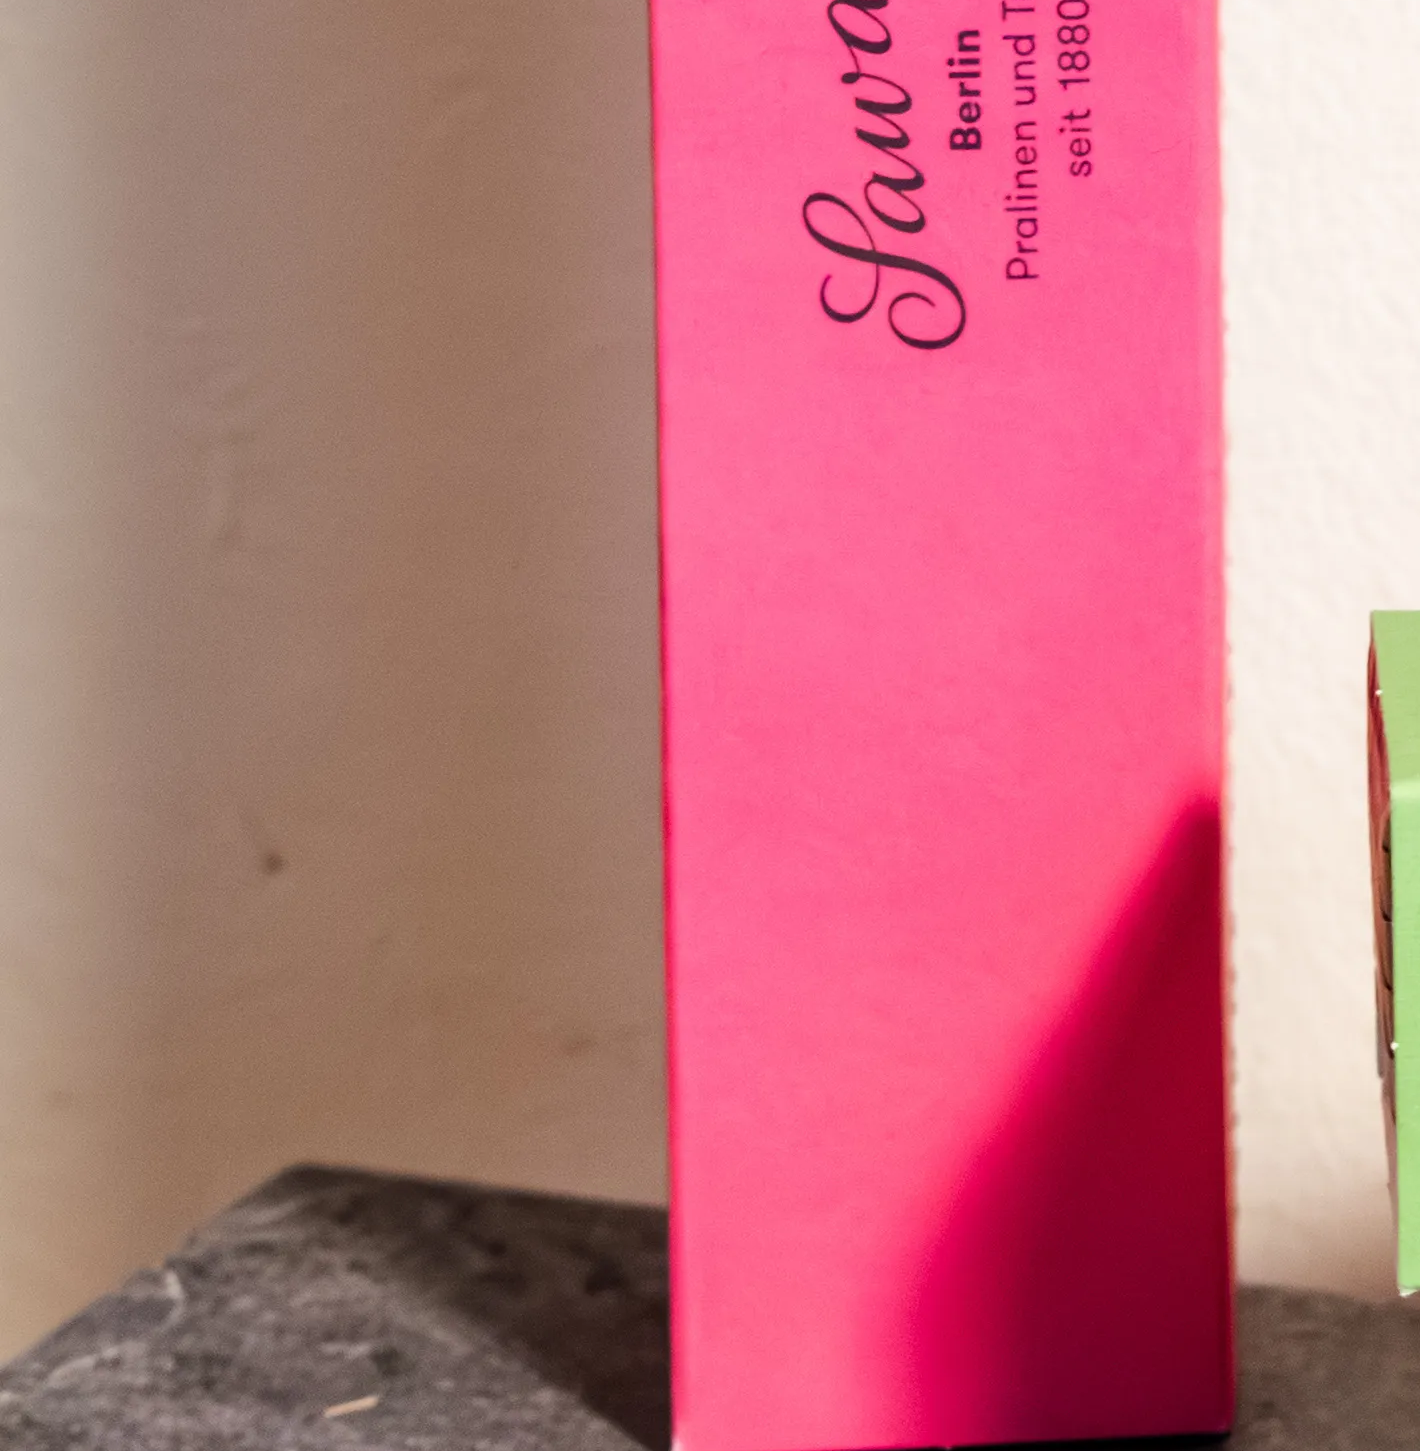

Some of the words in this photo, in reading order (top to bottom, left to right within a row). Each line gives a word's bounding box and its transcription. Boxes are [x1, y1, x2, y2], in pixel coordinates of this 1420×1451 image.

[948, 29, 982, 151] Berlin
[1004, 34, 1037, 107] und
[1057, 110, 1092, 178] seit
[1002, 119, 1039, 281] Pralinen
